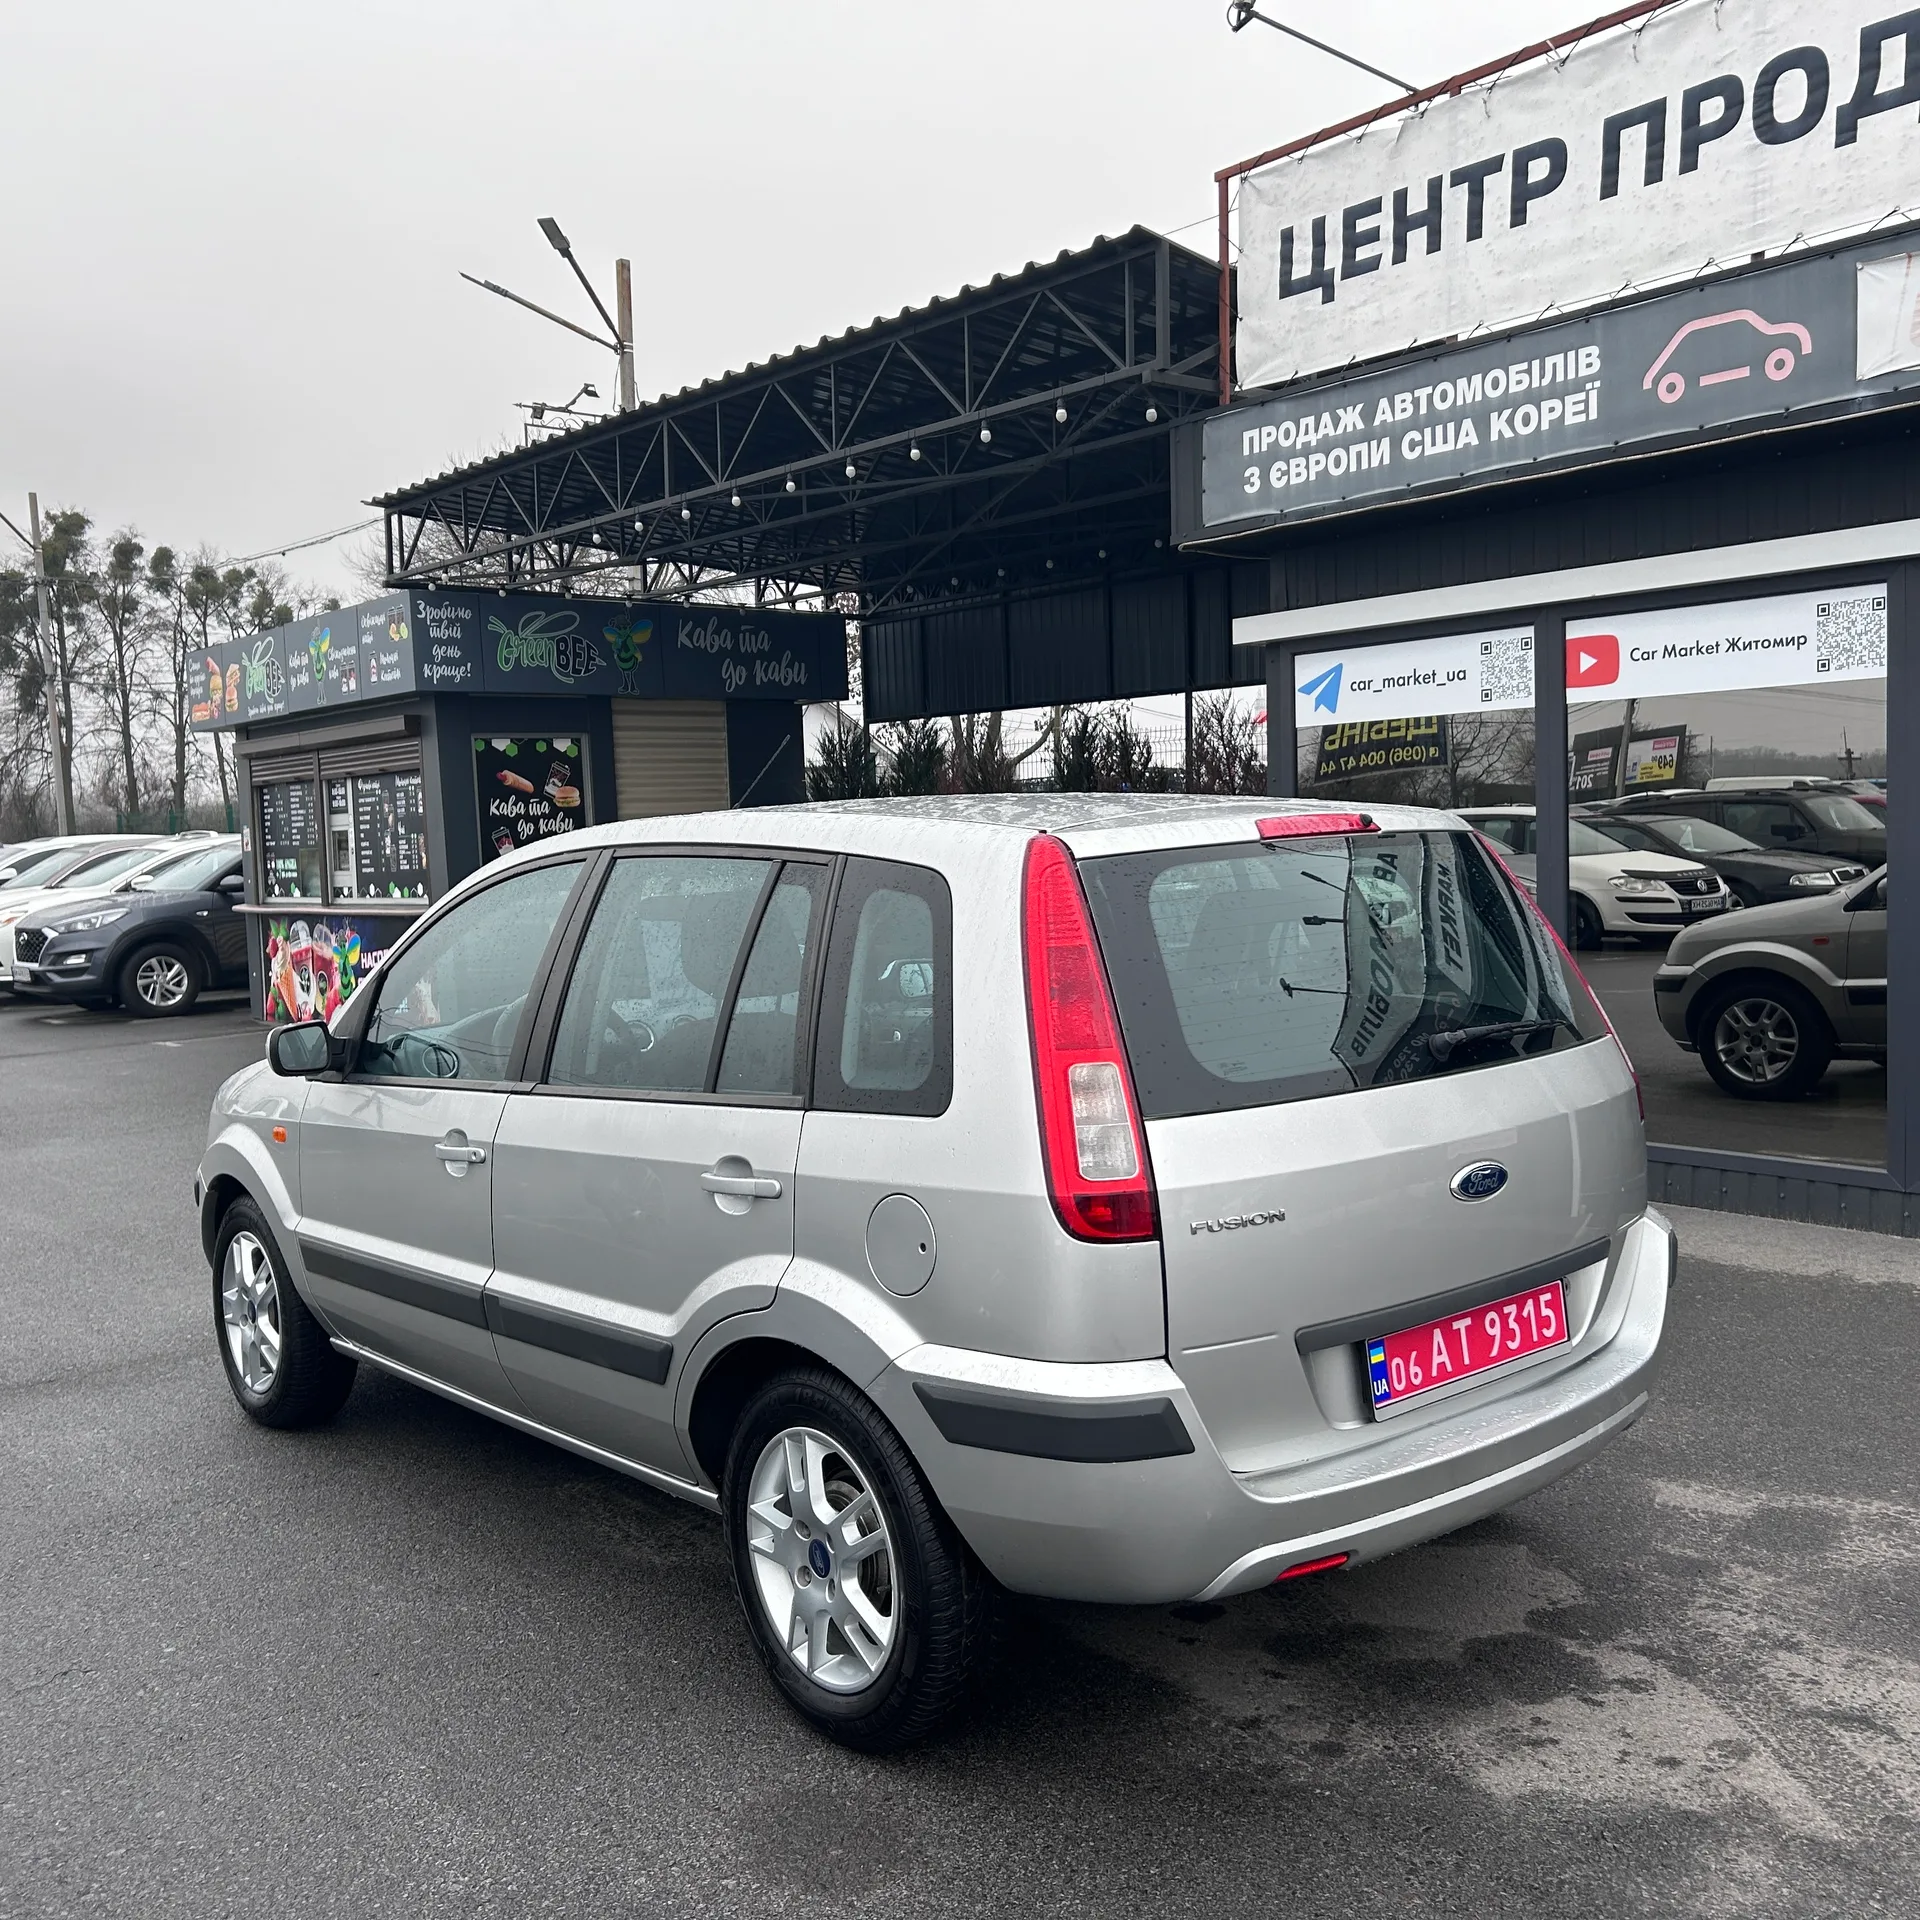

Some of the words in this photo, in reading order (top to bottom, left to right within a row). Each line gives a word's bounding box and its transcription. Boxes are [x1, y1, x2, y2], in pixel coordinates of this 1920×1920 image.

[1279, 138, 1567, 305] ЦЕНТР
[1243, 403, 1364, 456] ПРОДАЖ
[1373, 346, 1601, 427] АВТОМОБІЛІВ
[1243, 466, 1261, 494] З
[1270, 437, 1391, 489] ЄВРОПИ
[1401, 418, 1479, 460] США
[1490, 381, 1601, 442] КОРЕЇ
[416, 600, 472, 625] Зробимо
[429, 620, 461, 639] твій
[678, 616, 734, 653] Кава
[738, 625, 772, 653] та
[432, 644, 462, 662] день
[1630, 647, 1658, 663] Car
[1662, 640, 1721, 660] Market
[1724, 633, 1808, 655] Житомир
[423, 663, 471, 685] краще!
[721, 657, 747, 692] до
[753, 650, 808, 686] кави
[1350, 668, 1467, 694] car_market_ua
[490, 795, 526, 817] Кава
[529, 798, 551, 816] та
[517, 818, 534, 840] до
[538, 811, 574, 834] кави
[1468, 1168, 1500, 1196] Ford
[1190, 1209, 1286, 1236] FUSION
[1374, 1378, 1389, 1396] UA
[1391, 1350, 1423, 1391] 06
[1432, 1316, 1473, 1377] AT
[1485, 1292, 1558, 1358] 9315
